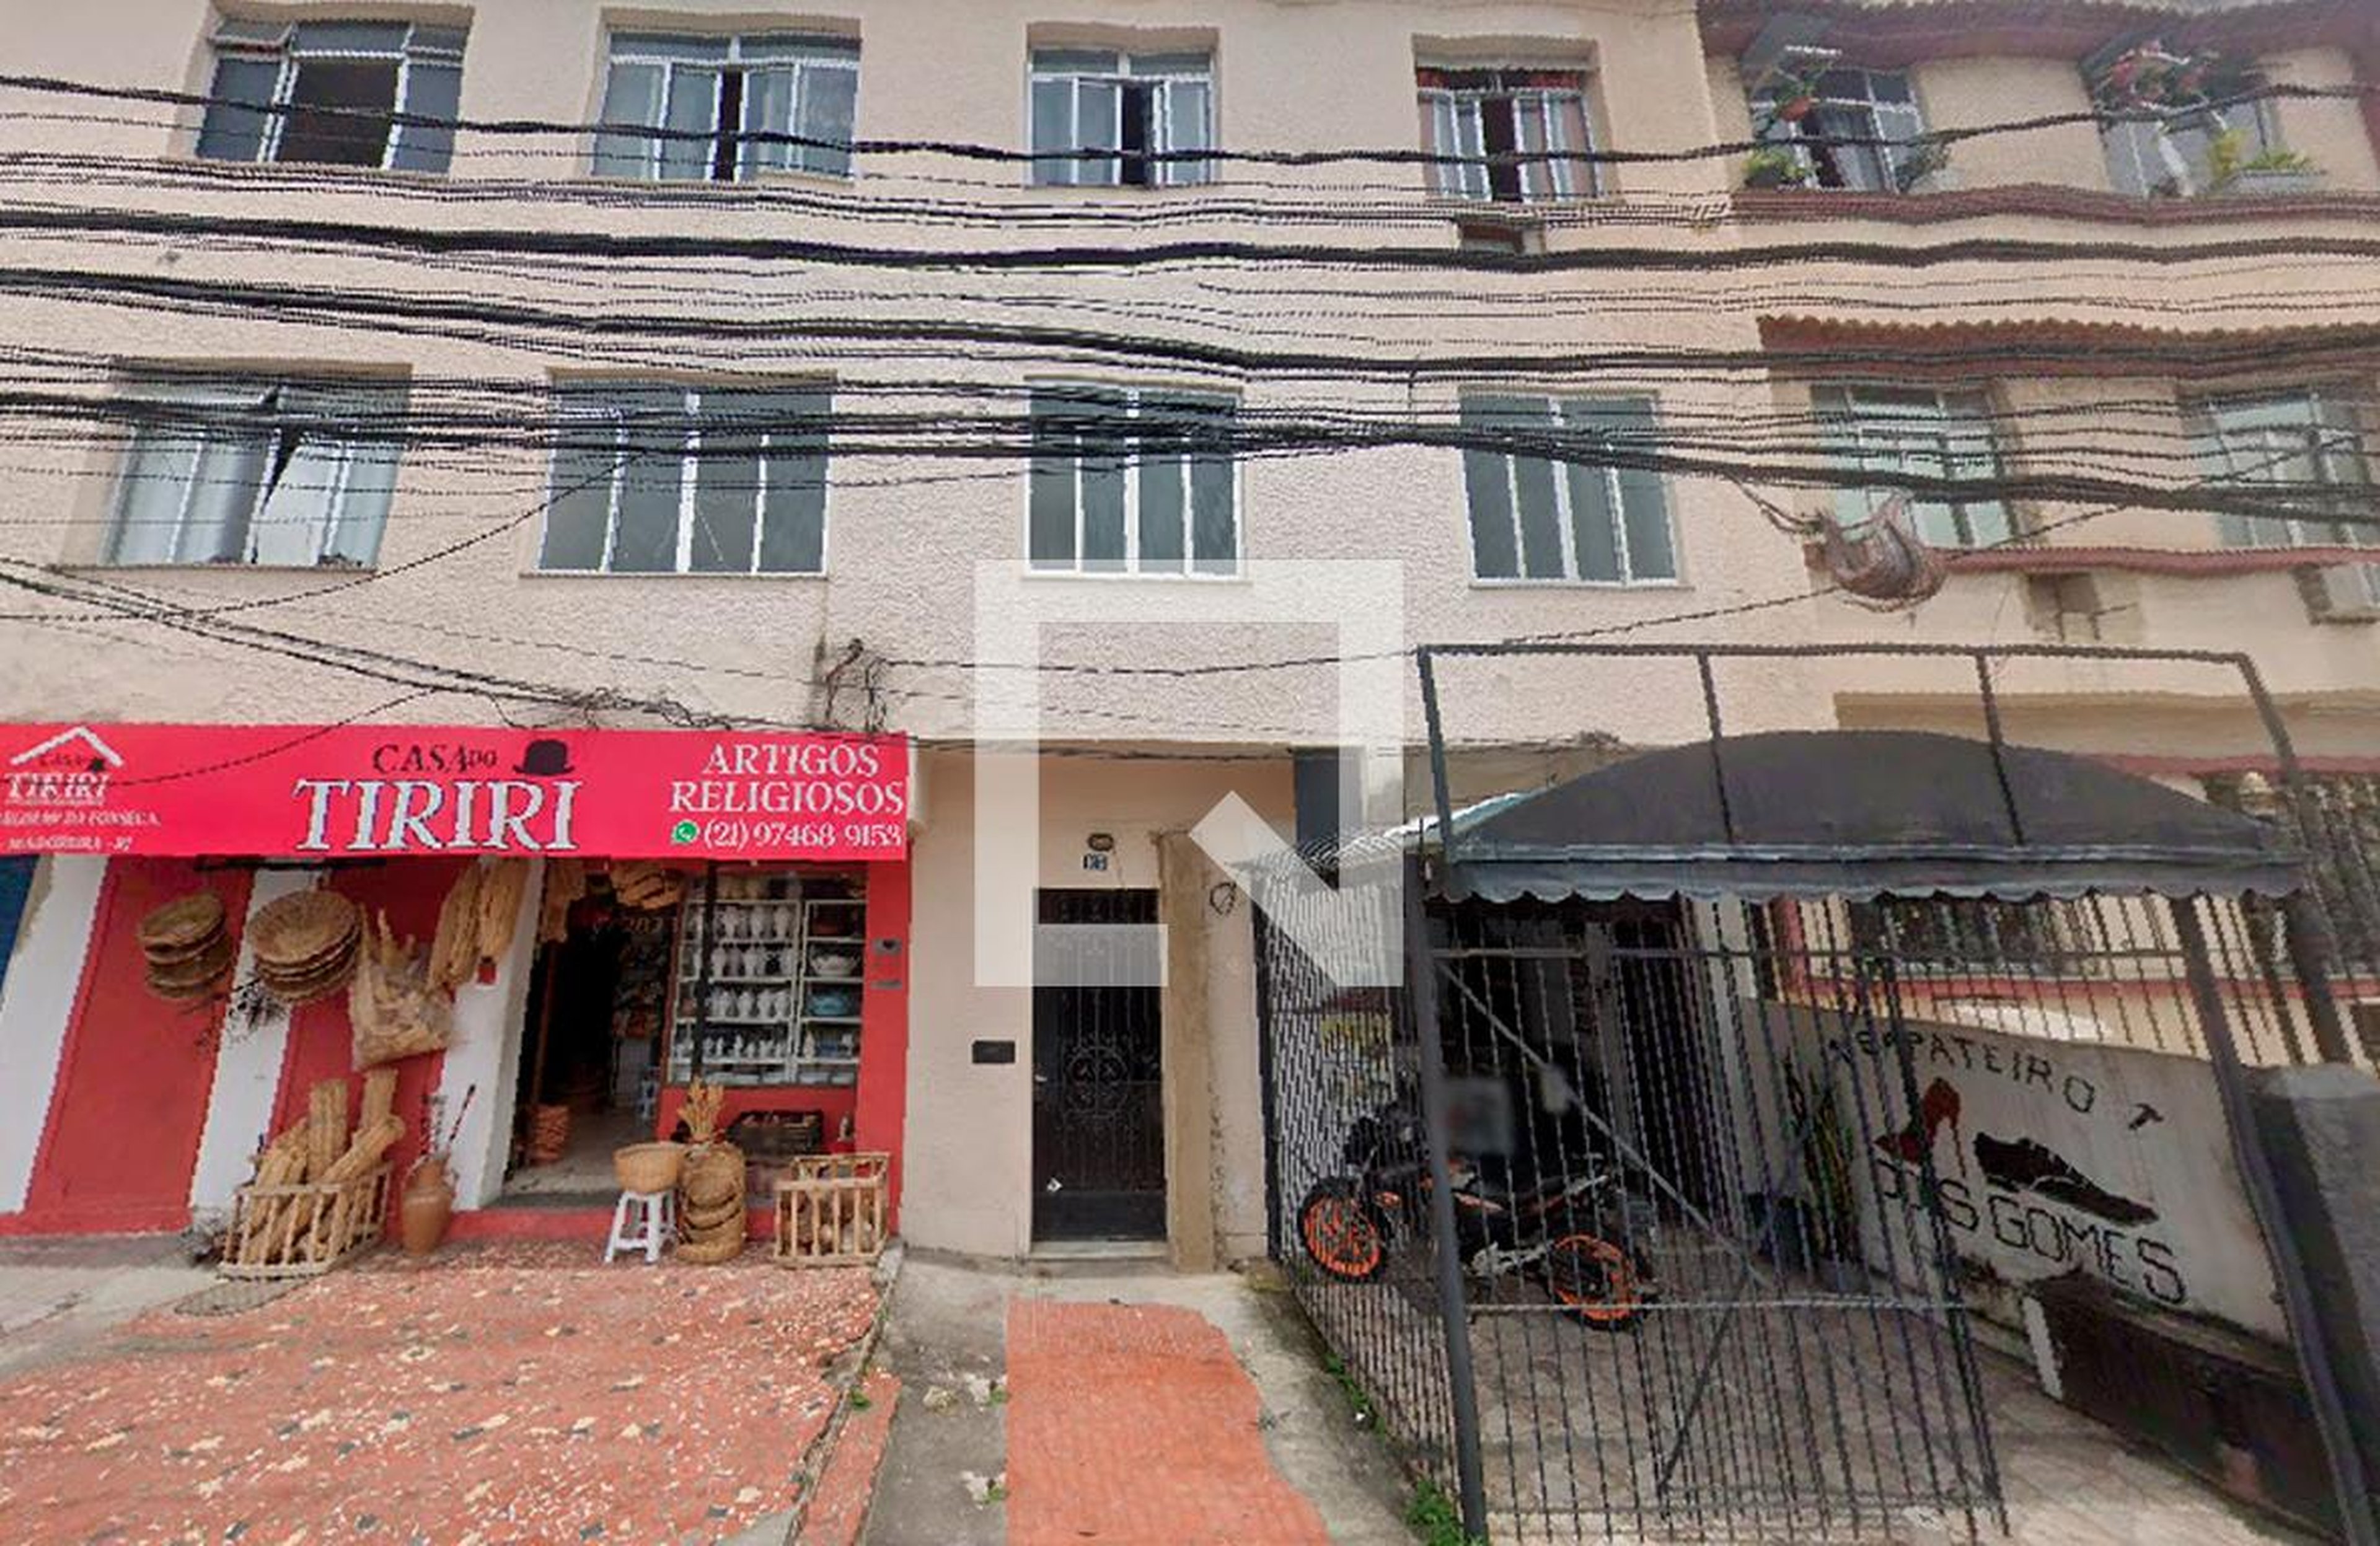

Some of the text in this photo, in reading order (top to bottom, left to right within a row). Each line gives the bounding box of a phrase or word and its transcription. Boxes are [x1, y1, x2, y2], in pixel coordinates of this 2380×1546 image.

[373, 744, 466, 774] CASA
[702, 744, 880, 778] ARTIGOS
[4, 772, 110, 799] TIRIRI
[669, 781, 904, 815] RELIGIOSOS
[292, 778, 583, 851] TIRIRI
[703, 817, 749, 849] (21)
[752, 821, 837, 848] 97468
[1988, 1195, 2187, 1304] GOMES
